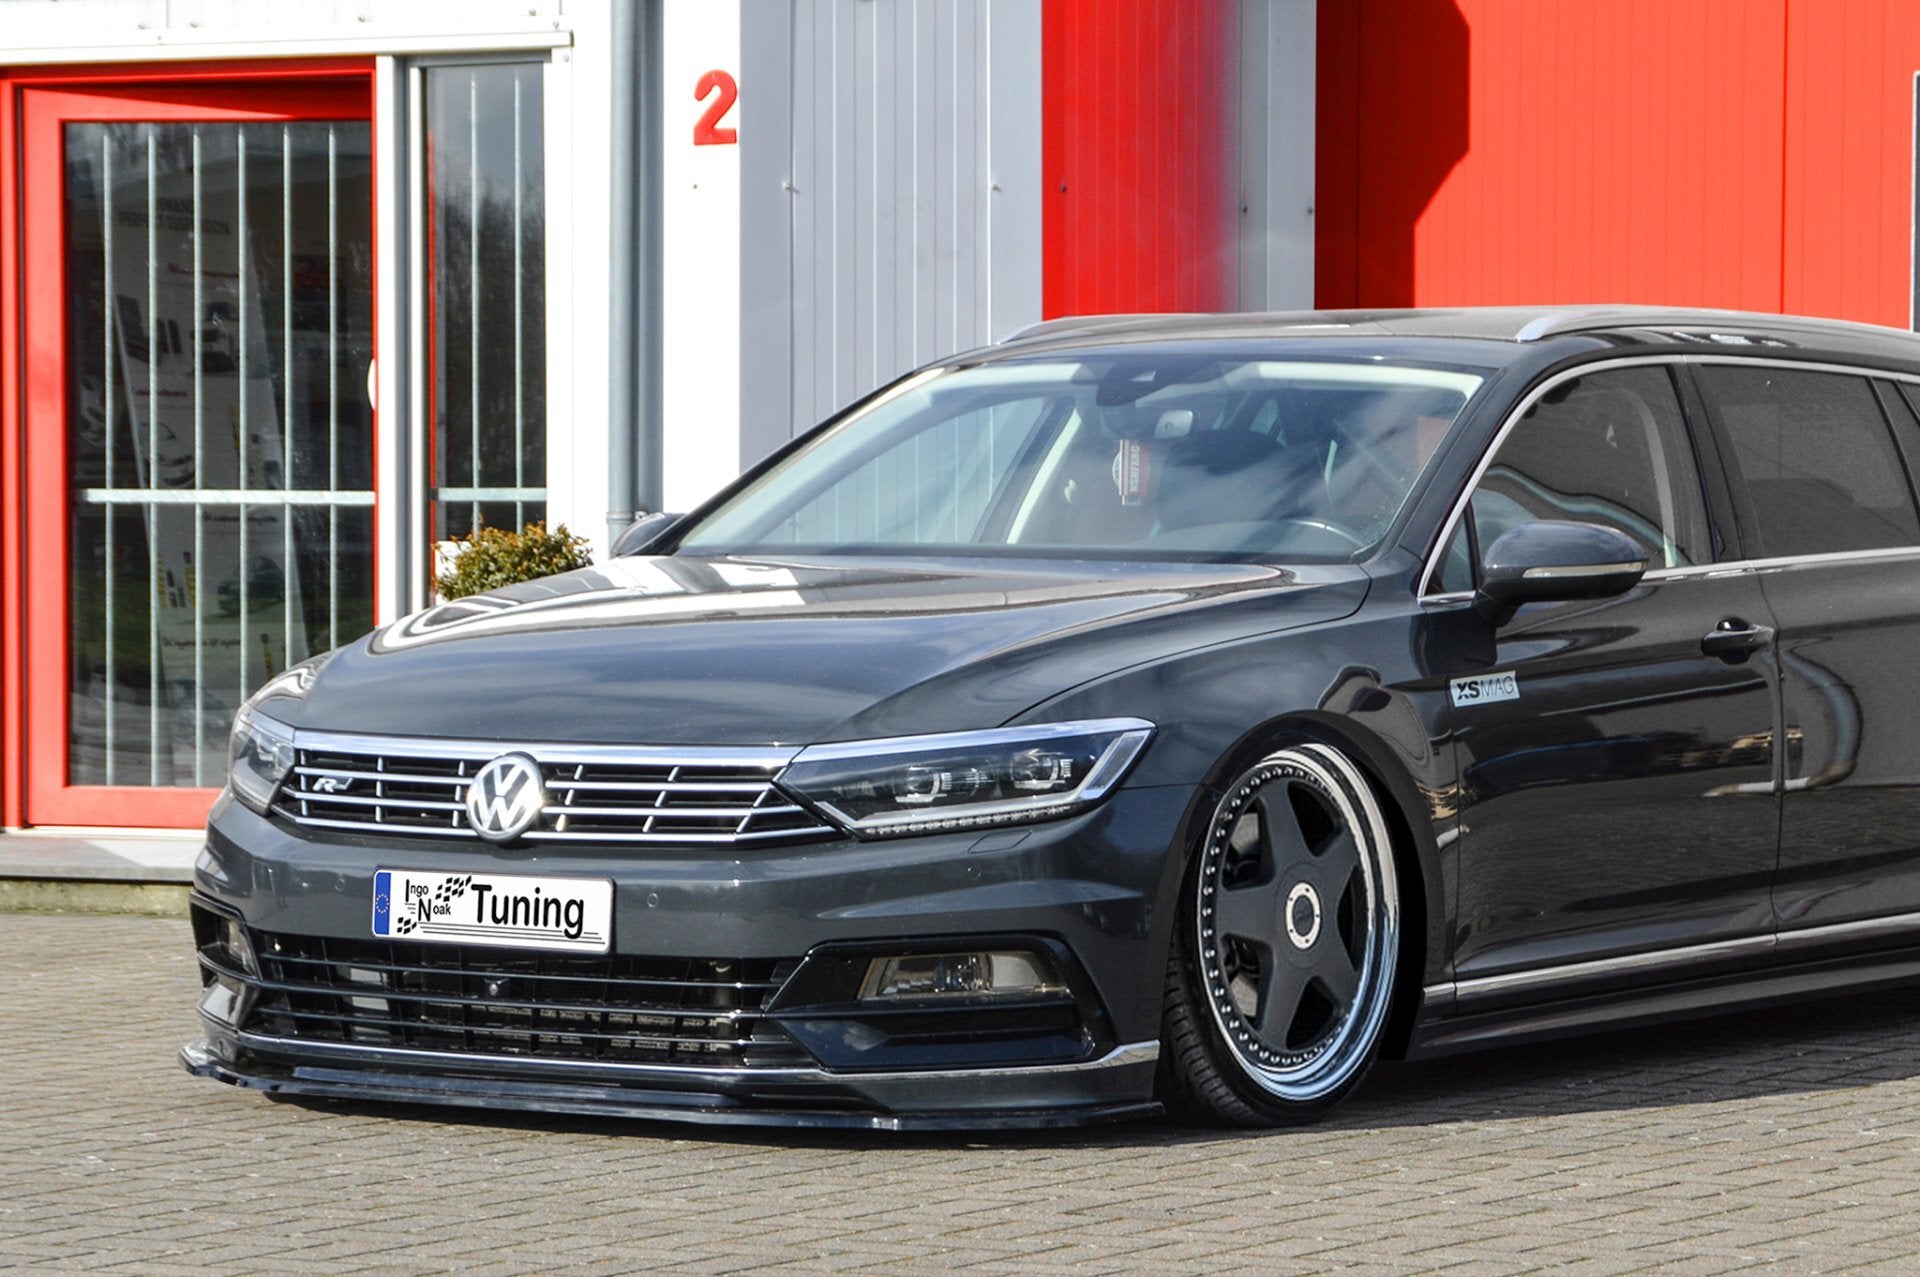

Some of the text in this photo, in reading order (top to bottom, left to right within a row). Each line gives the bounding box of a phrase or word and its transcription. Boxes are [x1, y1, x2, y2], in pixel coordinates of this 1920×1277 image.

[693, 69, 738, 146] 2
[1456, 675, 1515, 700] XSMAG
[405, 879, 429, 903] Ingo
[417, 898, 452, 922] Noak
[470, 883, 585, 940] Tuning
